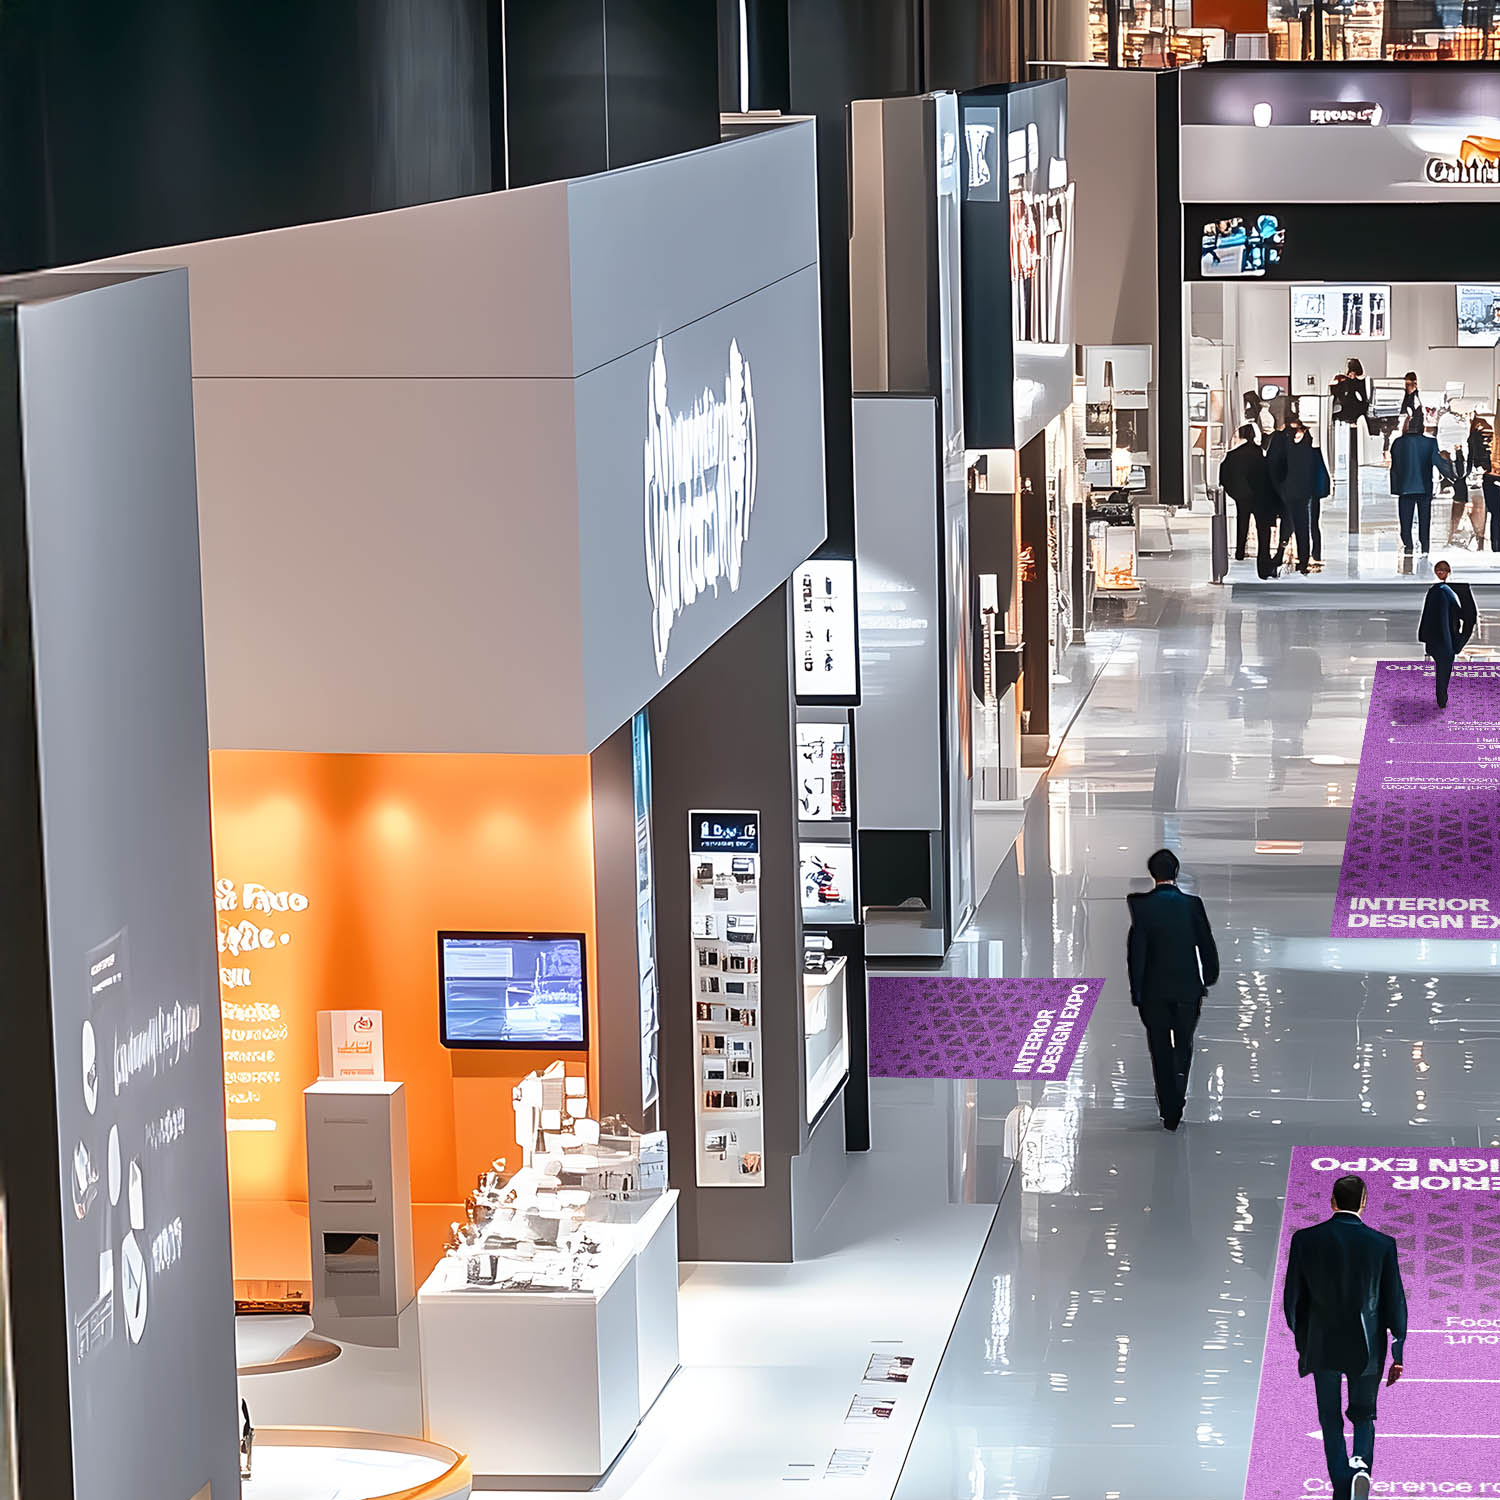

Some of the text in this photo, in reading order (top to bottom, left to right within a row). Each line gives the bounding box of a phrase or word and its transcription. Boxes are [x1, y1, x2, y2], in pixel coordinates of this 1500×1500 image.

[1350, 897, 1491, 912] INTERIOR
[1347, 913, 1464, 929] DESIGN
[1036, 984, 1089, 1074] DESIGN EXPO
[1012, 1009, 1056, 1073] INTERIOR
[1310, 1157, 1418, 1172] EXPO
